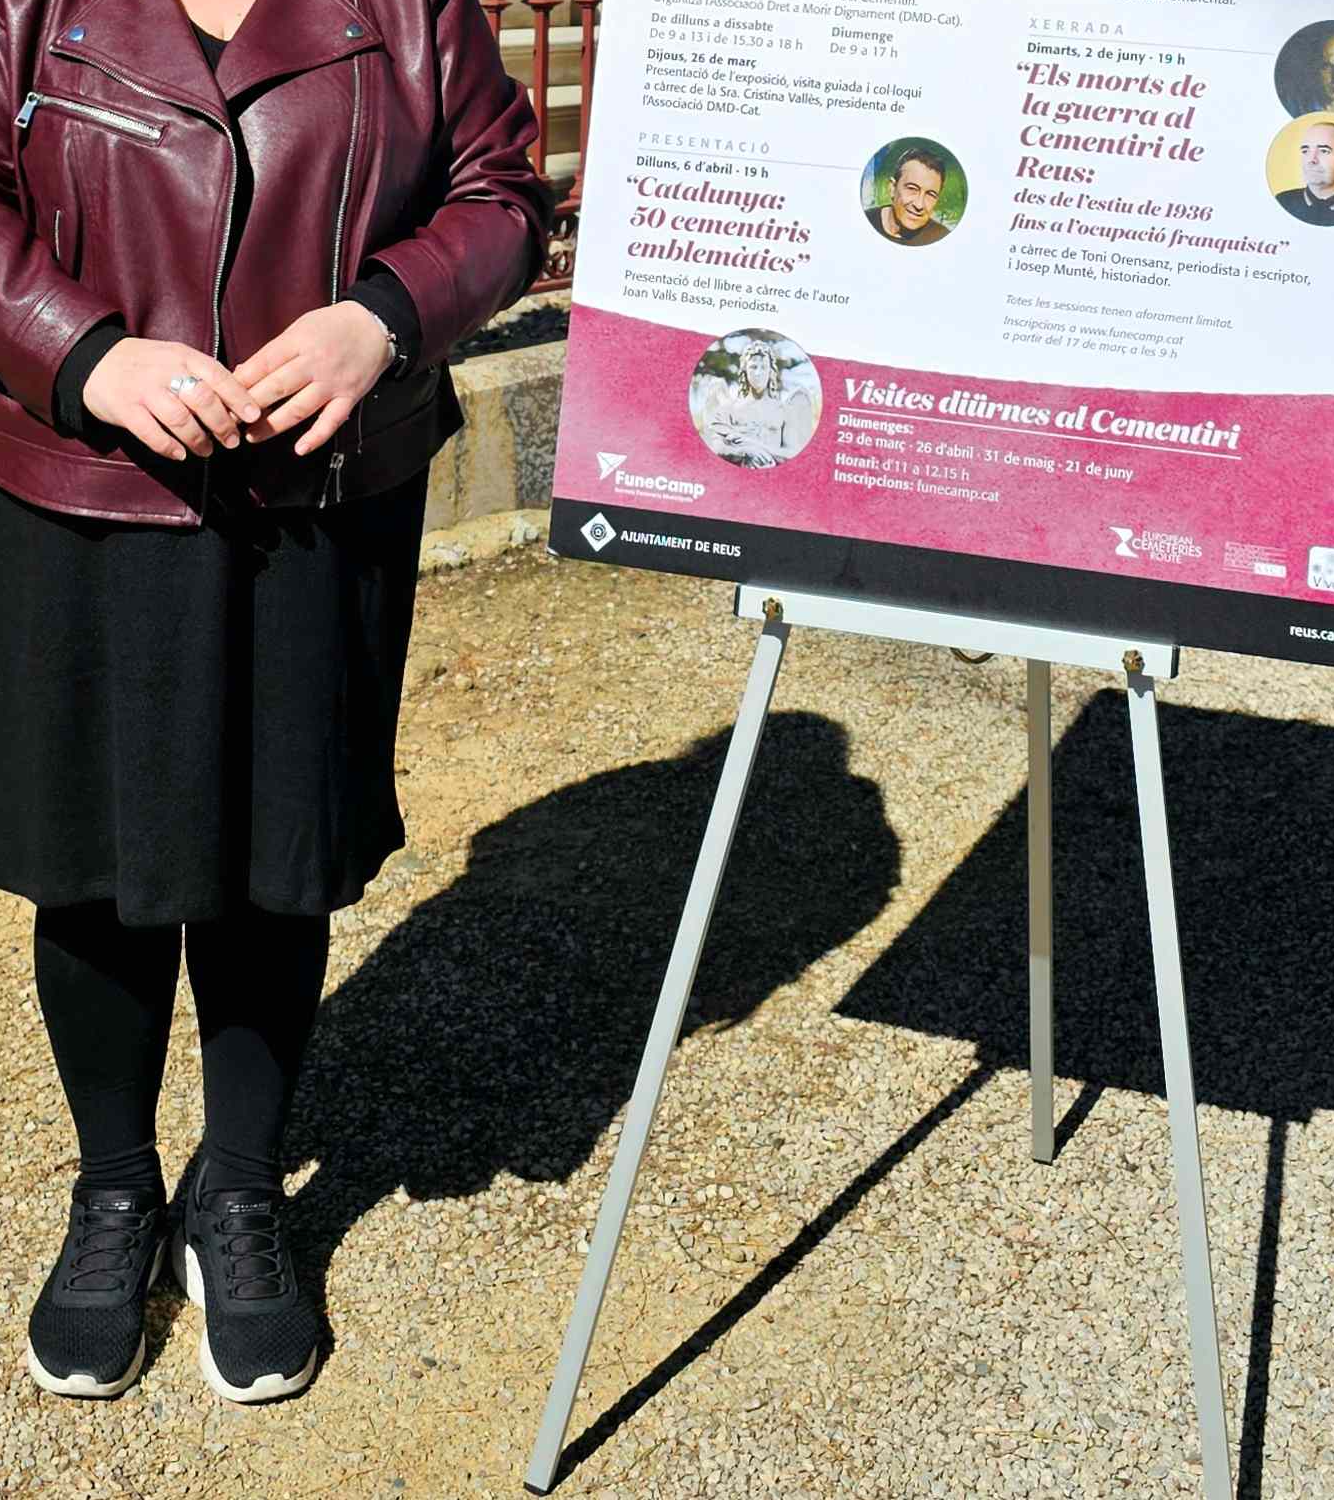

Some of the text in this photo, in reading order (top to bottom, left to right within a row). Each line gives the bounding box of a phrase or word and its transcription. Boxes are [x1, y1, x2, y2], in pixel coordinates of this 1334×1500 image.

[1028, 17, 1124, 36] XERRADA
[691, 52, 706, 64] 26
[708, 52, 724, 65] de
[727, 57, 757, 70] març
[1097, 46, 1114, 60] de
[1116, 48, 1146, 66] juny
[1158, 52, 1173, 64] 19
[645, 63, 709, 80] Presentació
[711, 68, 727, 82] de
[792, 75, 822, 90] visita
[823, 79, 863, 94] guiada
[873, 83, 923, 101] col·loqui
[1016, 62, 1207, 99] “Els morts de
[1021, 92, 1196, 130] la guerra al
[638, 131, 770, 155] PRESENTACIÓ
[1019, 124, 1205, 162] Cementiri de
[744, 166, 758, 178] 19
[1015, 156, 1095, 184] Reus:
[626, 176, 786, 214] “Catalunya:
[1013, 187, 1214, 222] des de l’estiu de 1936
[629, 206, 811, 244] 50 cementiris
[1009, 212, 1047, 232] fins
[1066, 218, 1167, 243] l’ocupació
[1167, 228, 1290, 256] franquista”
[627, 238, 811, 273] emblemàtics”
[1020, 243, 1058, 258] càrrec
[1061, 246, 1078, 260] de
[1080, 248, 1107, 263] Toni
[1110, 252, 1173, 272] Orensanz,
[1177, 260, 1241, 277] periodista
[1252, 268, 1311, 286] escriptor,
[624, 269, 690, 287] Presentació
[692, 275, 711, 289] del
[713, 277, 743, 293] llibre
[755, 284, 791, 299] càrrec
[793, 287, 810, 301] de
[1014, 259, 1051, 277] Josep
[1053, 263, 1097, 281] Munté,
[1101, 267, 1171, 287] historiador.
[622, 285, 649, 299] Joan
[838, 413, 915, 436] Diumenges:
[845, 378, 1242, 450] Visites diürnes al Cementiri
[835, 452, 880, 470] Horari:
[925, 464, 958, 480] 12.15
[837, 430, 854, 444] 29
[855, 432, 873, 447] de
[874, 437, 907, 454] març
[916, 440, 933, 454] 26
[983, 449, 999, 463] 31
[1003, 451, 1021, 466] de
[1023, 456, 1055, 474] maig
[1065, 459, 1081, 473] 21
[1085, 461, 1103, 476] de
[1103, 464, 1134, 483] juny
[615, 471, 705, 498] FuneCamp
[833, 468, 1000, 503] Inscripcions: funecamp.cat
[620, 530, 741, 558] AJUNTAMENT DE REUS
[1132, 538, 1202, 557] CEMETERIES
